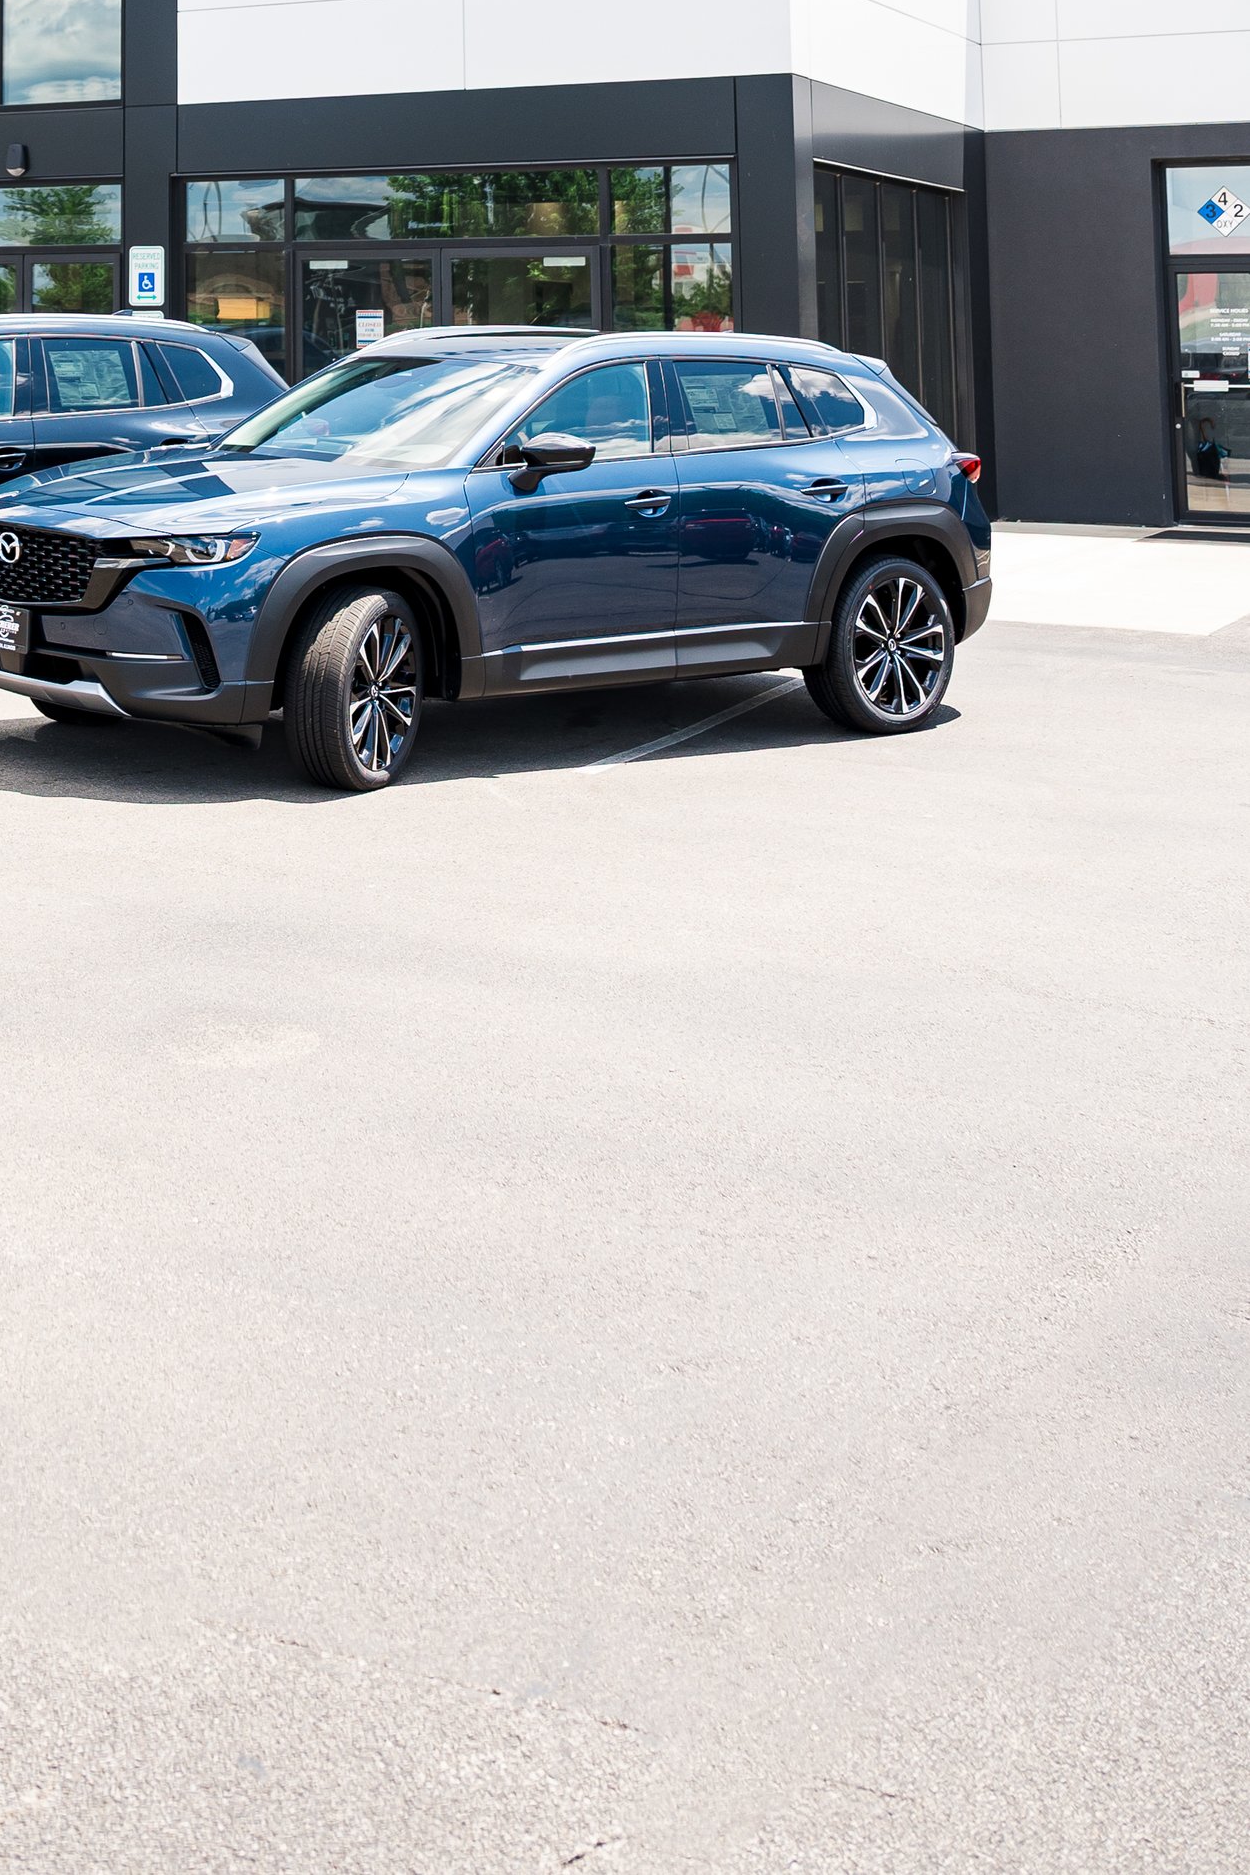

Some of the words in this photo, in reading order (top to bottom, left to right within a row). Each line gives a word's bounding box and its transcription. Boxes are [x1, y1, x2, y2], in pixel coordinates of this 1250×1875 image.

[1218, 191, 1228, 206] 4
[1205, 204, 1217, 218] 3
[1233, 203, 1244, 217] 2
[1216, 220, 1233, 228] OXY
